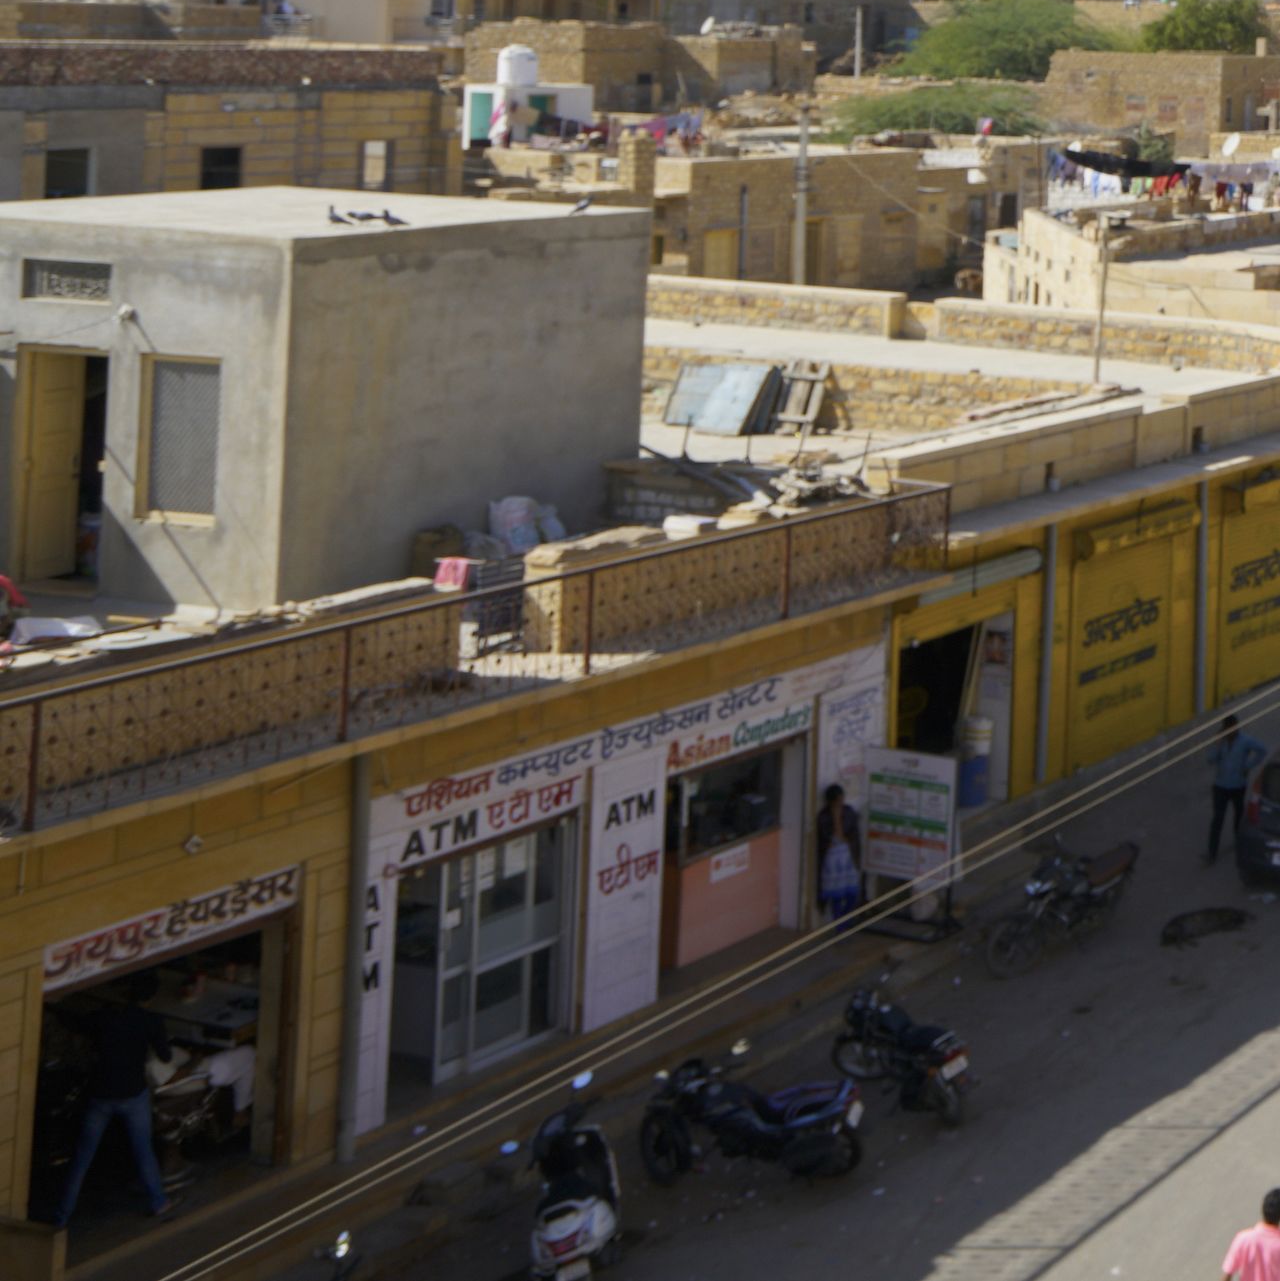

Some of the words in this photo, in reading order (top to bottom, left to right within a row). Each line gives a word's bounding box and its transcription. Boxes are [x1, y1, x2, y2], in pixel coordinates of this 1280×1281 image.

[667, 732, 732, 770] Asian
[404, 770, 495, 816] एशियन
[604, 788, 657, 830] ATM
[400, 809, 480, 862] ATM
